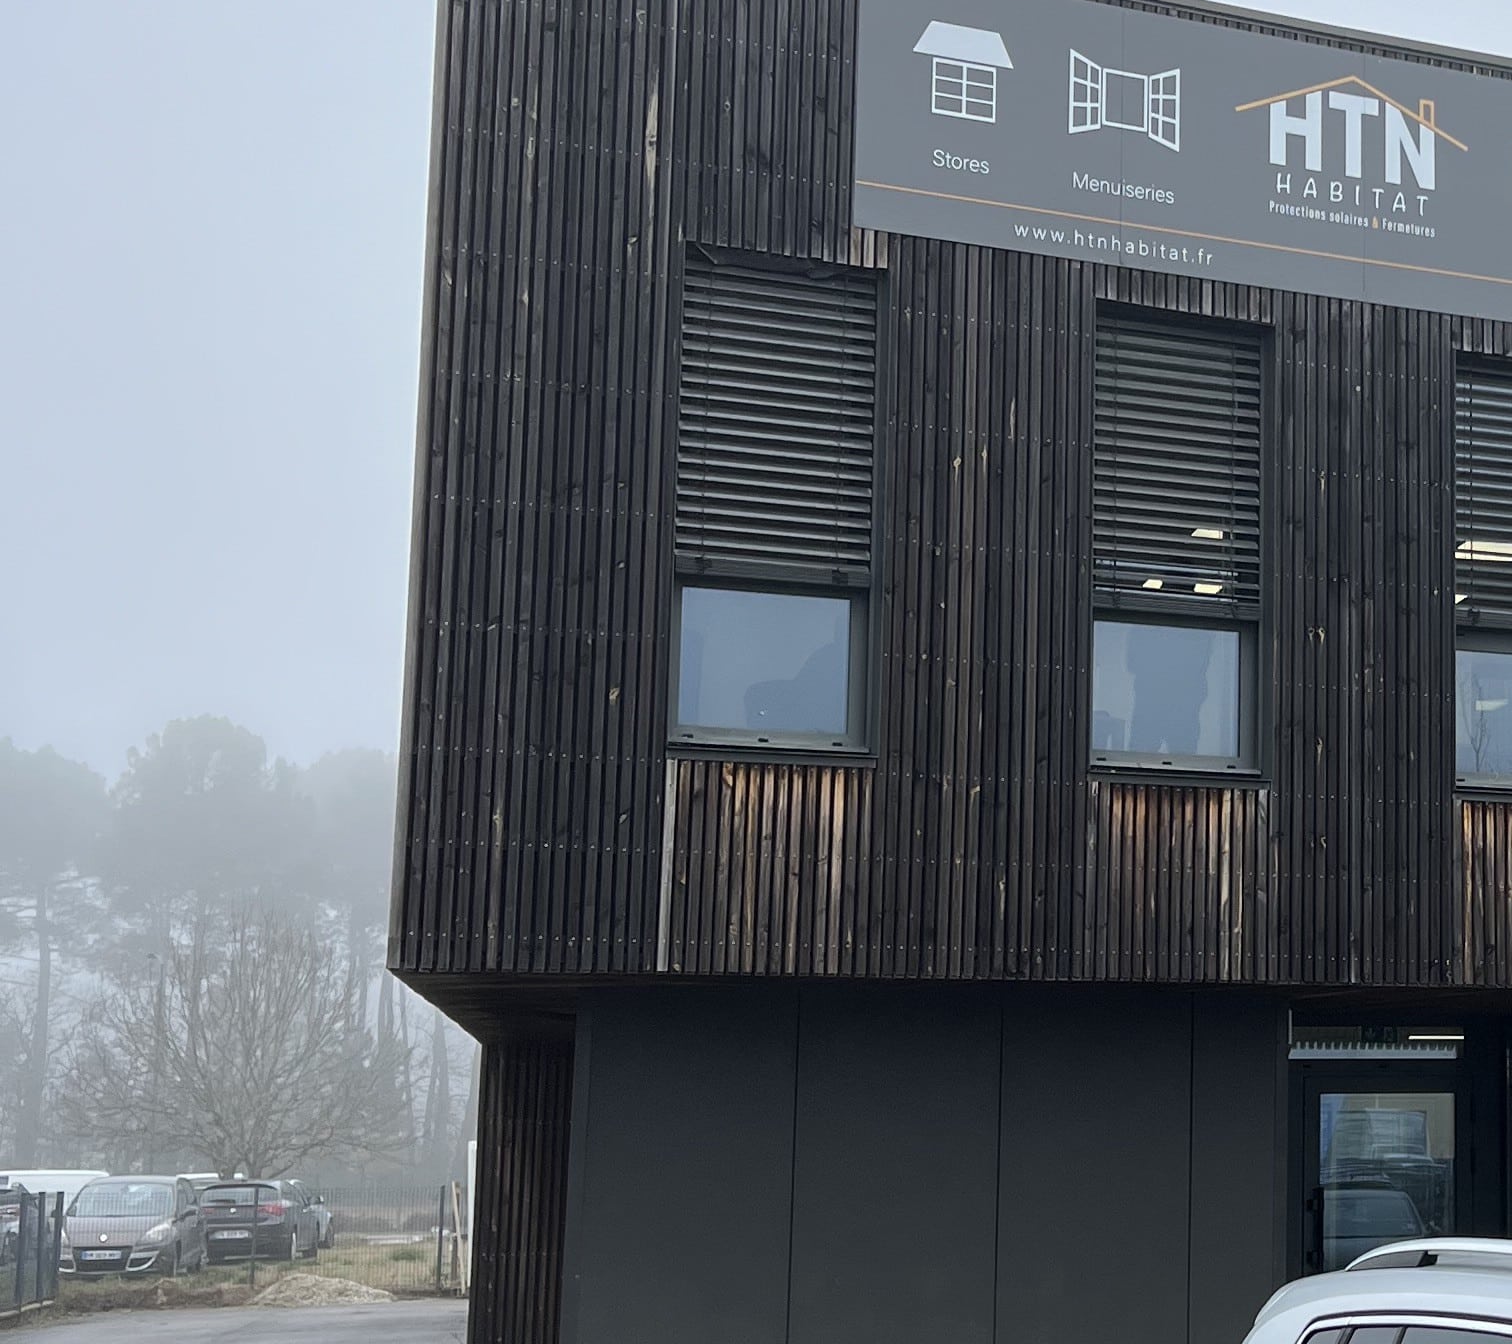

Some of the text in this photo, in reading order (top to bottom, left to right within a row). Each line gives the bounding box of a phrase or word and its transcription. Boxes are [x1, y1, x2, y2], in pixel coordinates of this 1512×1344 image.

[1269, 90, 1436, 191] HTN
[932, 148, 990, 175] Stores
[1072, 171, 1175, 205] Menuiseries
[1275, 172, 1430, 217] HABITAT
[1268, 199, 1327, 222] Protections
[1329, 211, 1369, 229] solaires
[1382, 217, 1436, 239] Fermetures
[1013, 223, 1213, 266] www.htnhabitat.fr
